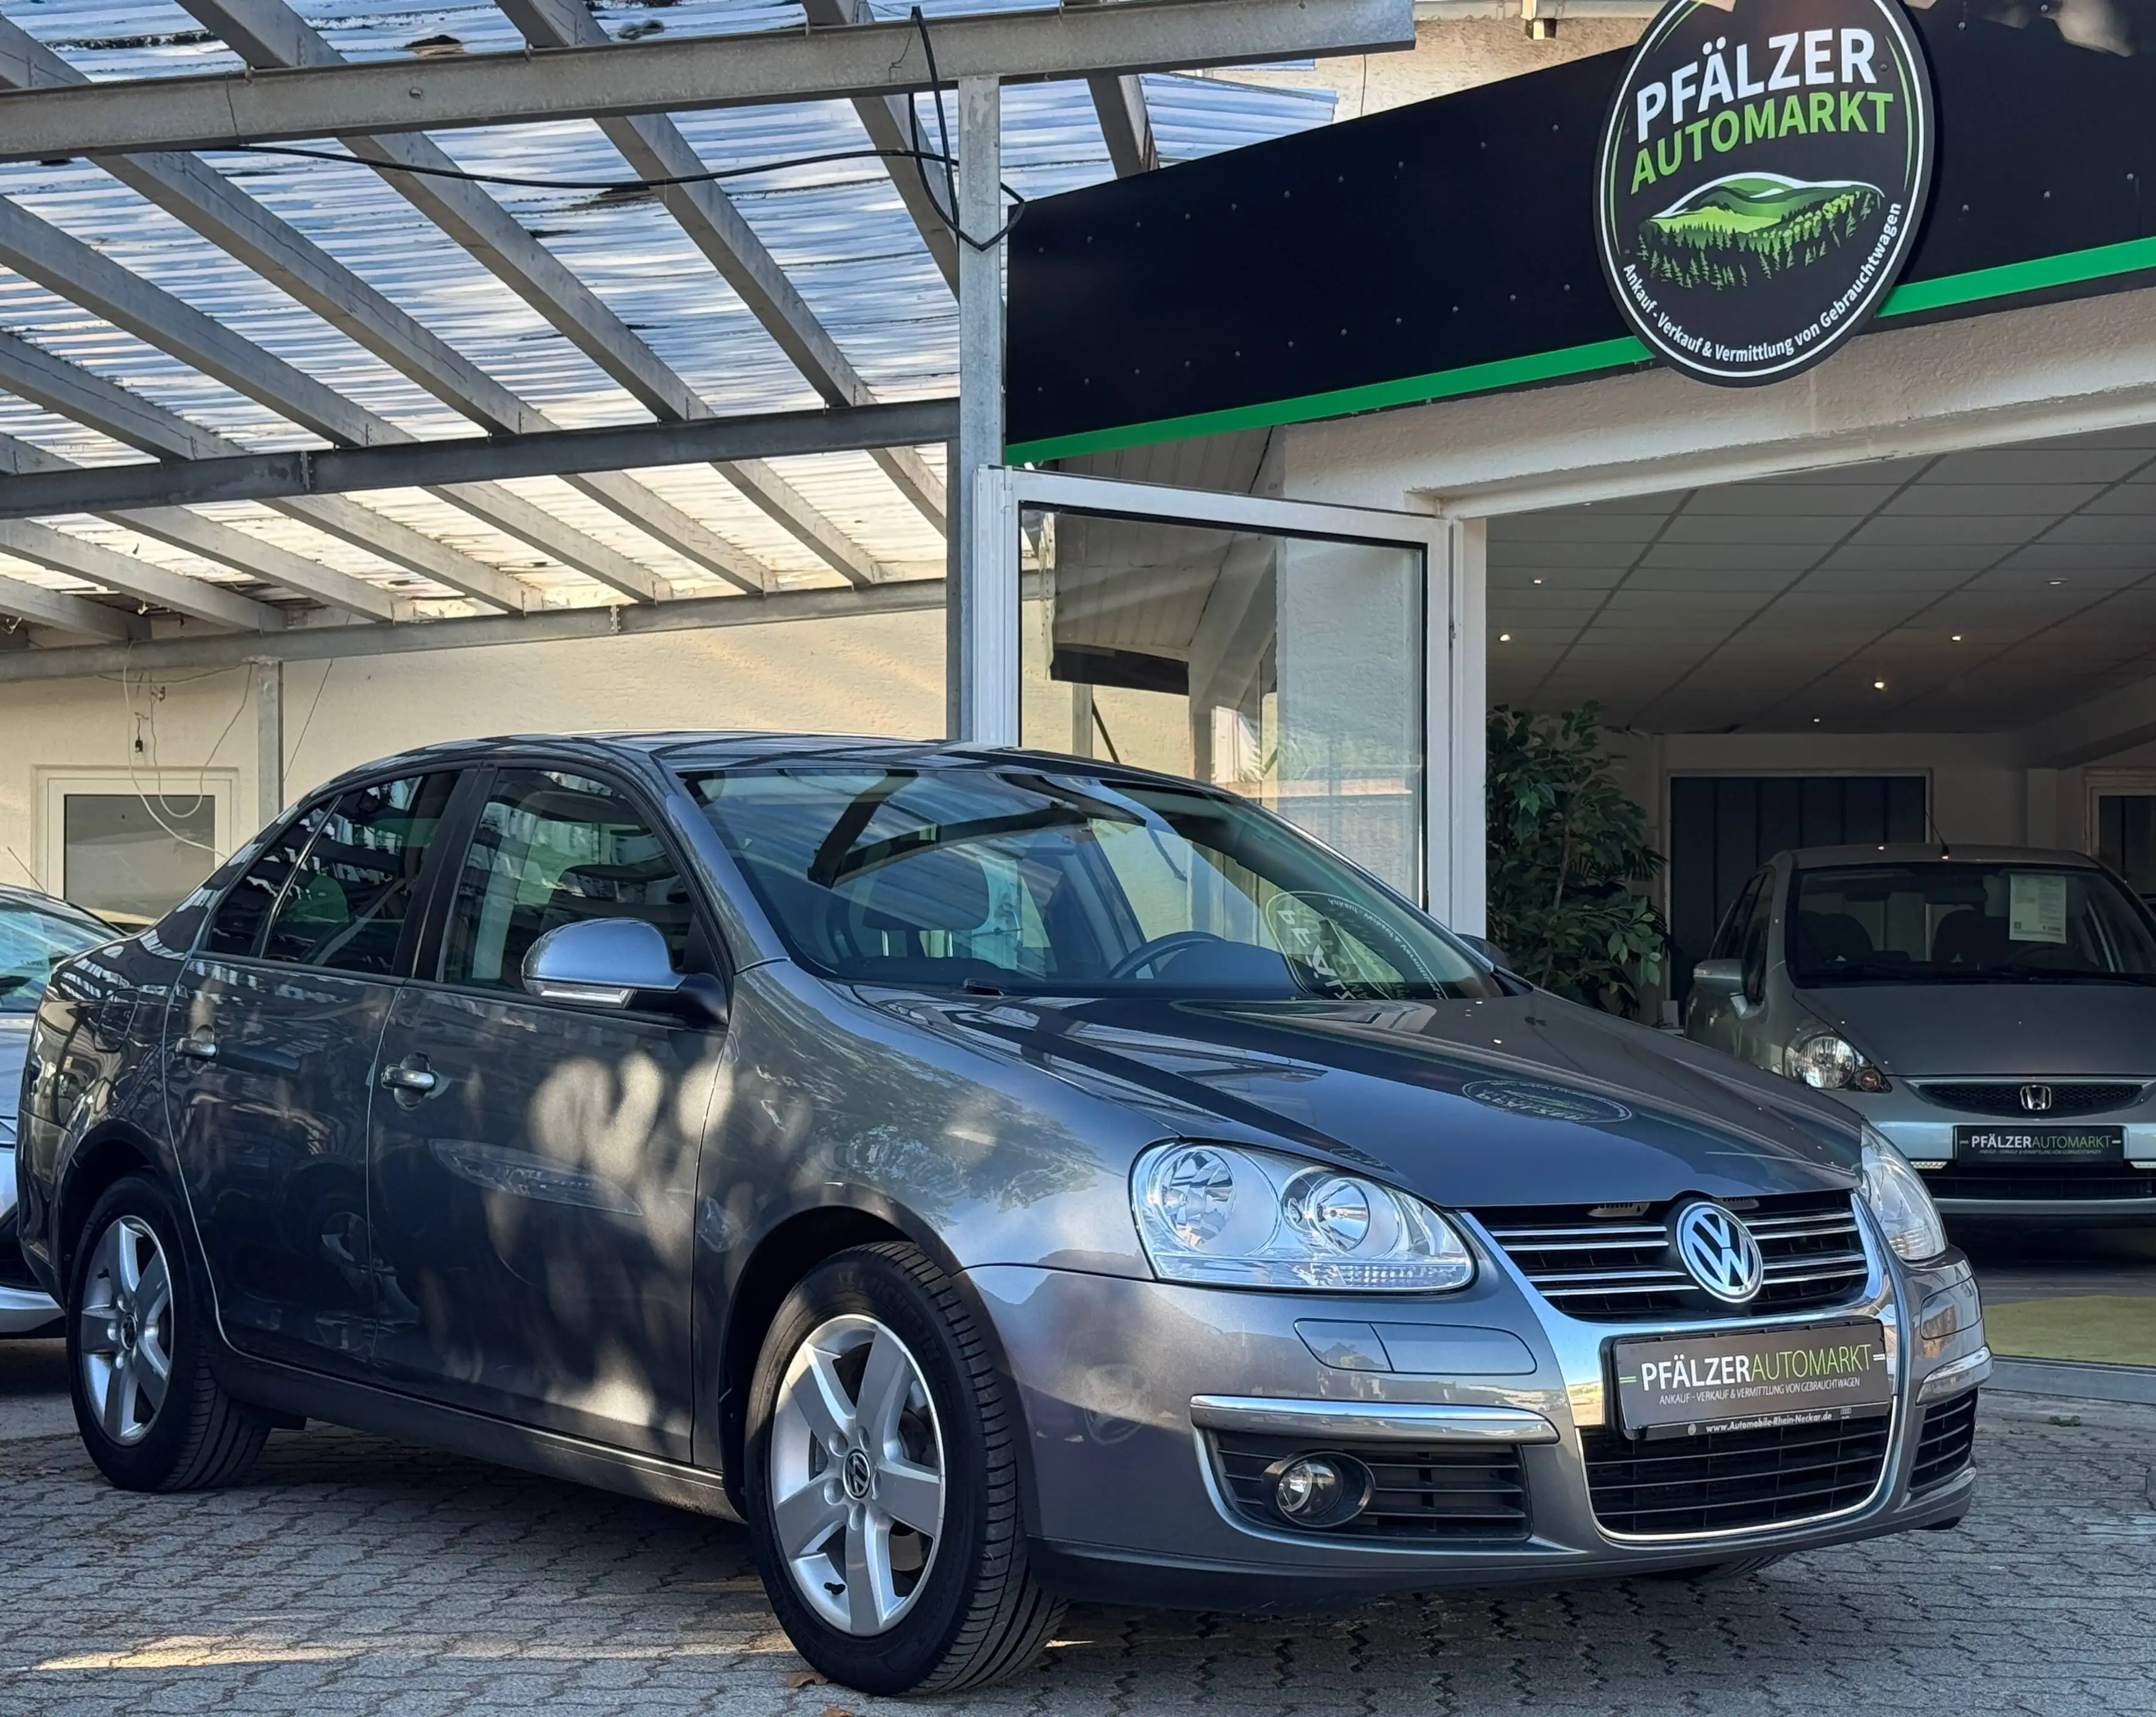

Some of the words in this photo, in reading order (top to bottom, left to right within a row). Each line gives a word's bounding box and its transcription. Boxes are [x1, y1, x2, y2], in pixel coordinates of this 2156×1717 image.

[1636, 27, 1878, 144] PFÄLZER
[1630, 90, 1894, 195] AUTOMARKT
[1623, 263, 1656, 314] Ankauf
[1656, 312, 1704, 354] Verkauf
[1716, 339, 1795, 362] Vermittlung
[1794, 323, 1821, 346] von
[1819, 202, 1902, 327] Gebrauchtwagen
[1659, 1392, 1691, 1405] ANKAUF
[1696, 1389, 1729, 1402] VERKAUF
[1736, 1384, 1784, 1398] VERMITTLUNG
[1785, 1382, 1801, 1394] VON
[1801, 1377, 1860, 1393] GEBRAUCHTWAGEN
